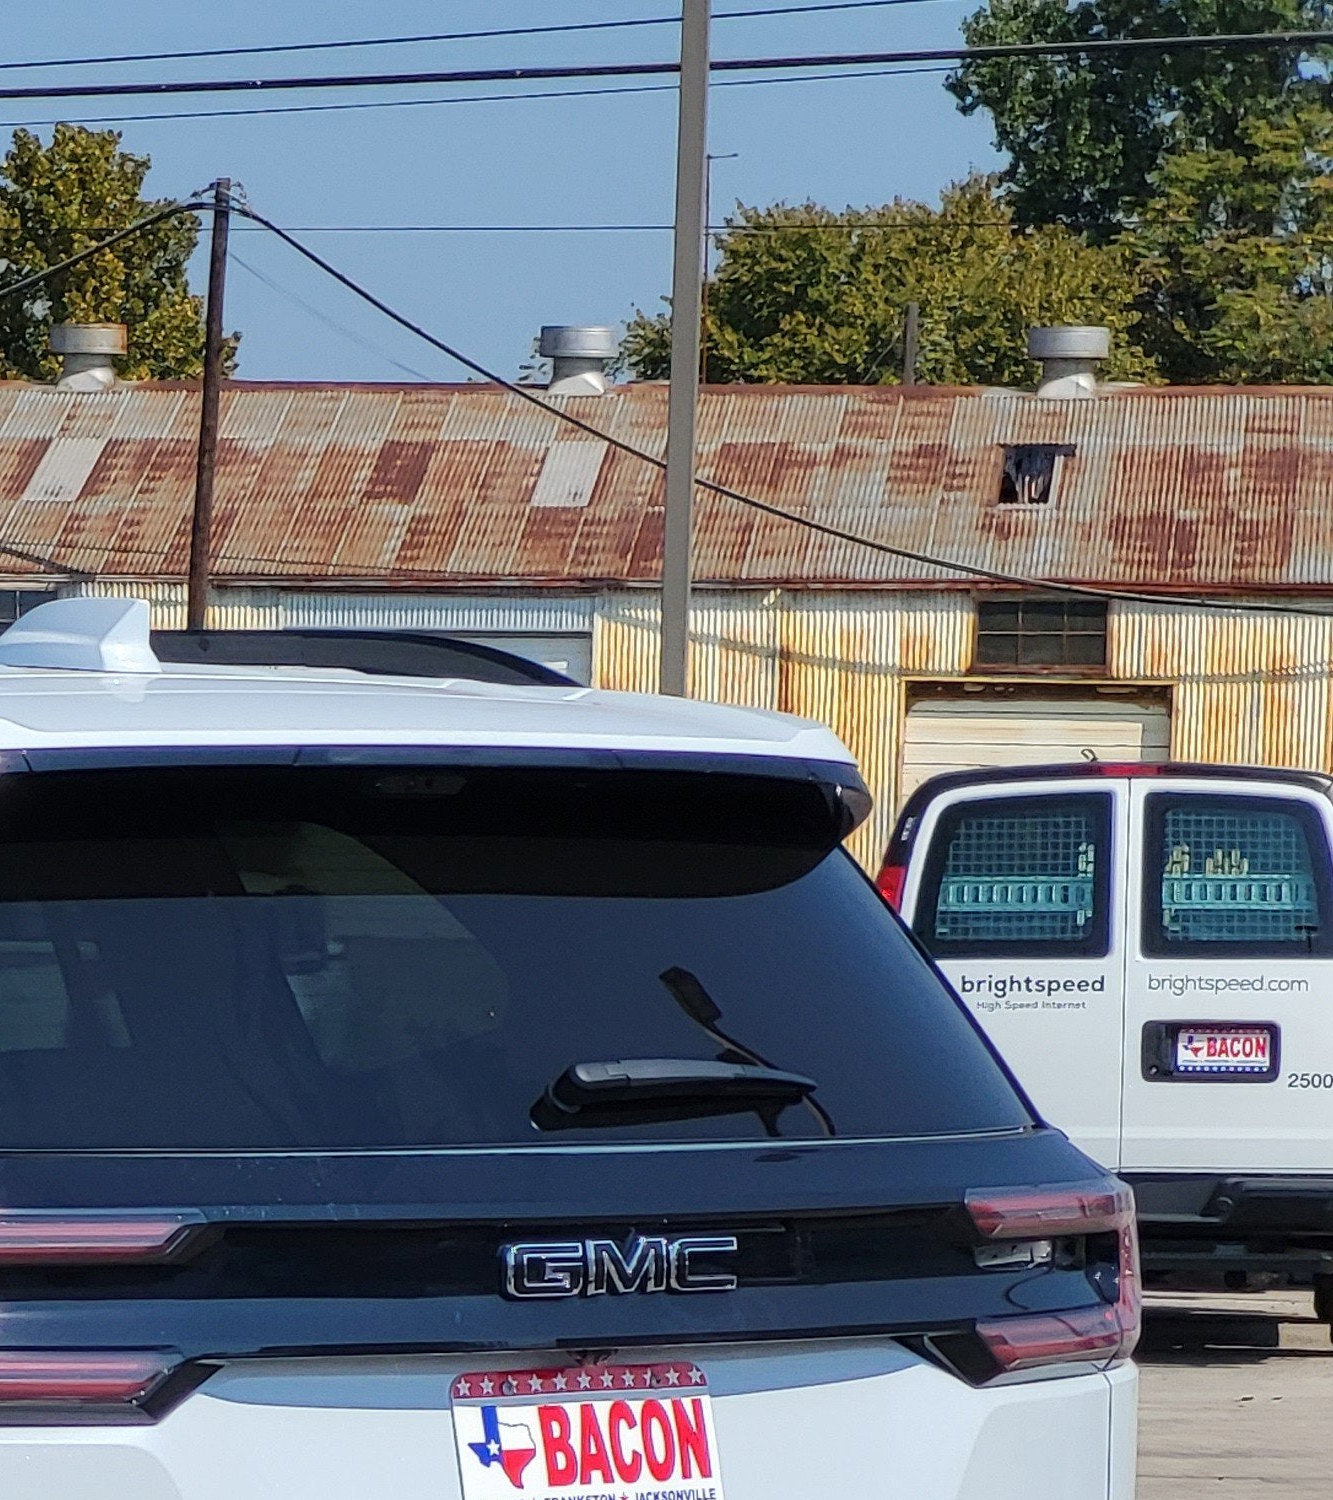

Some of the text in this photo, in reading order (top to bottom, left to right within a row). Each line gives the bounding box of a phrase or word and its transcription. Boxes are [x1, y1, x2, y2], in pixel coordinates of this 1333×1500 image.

[961, 975, 1105, 998] brightspeed
[1148, 974, 1309, 996] brightspeed.com
[977, 1001, 1086, 1012] High Speed Internet
[1206, 1036, 1267, 1059] BACON
[501, 1236, 738, 1298] GMC
[537, 1397, 712, 1487] BACON
